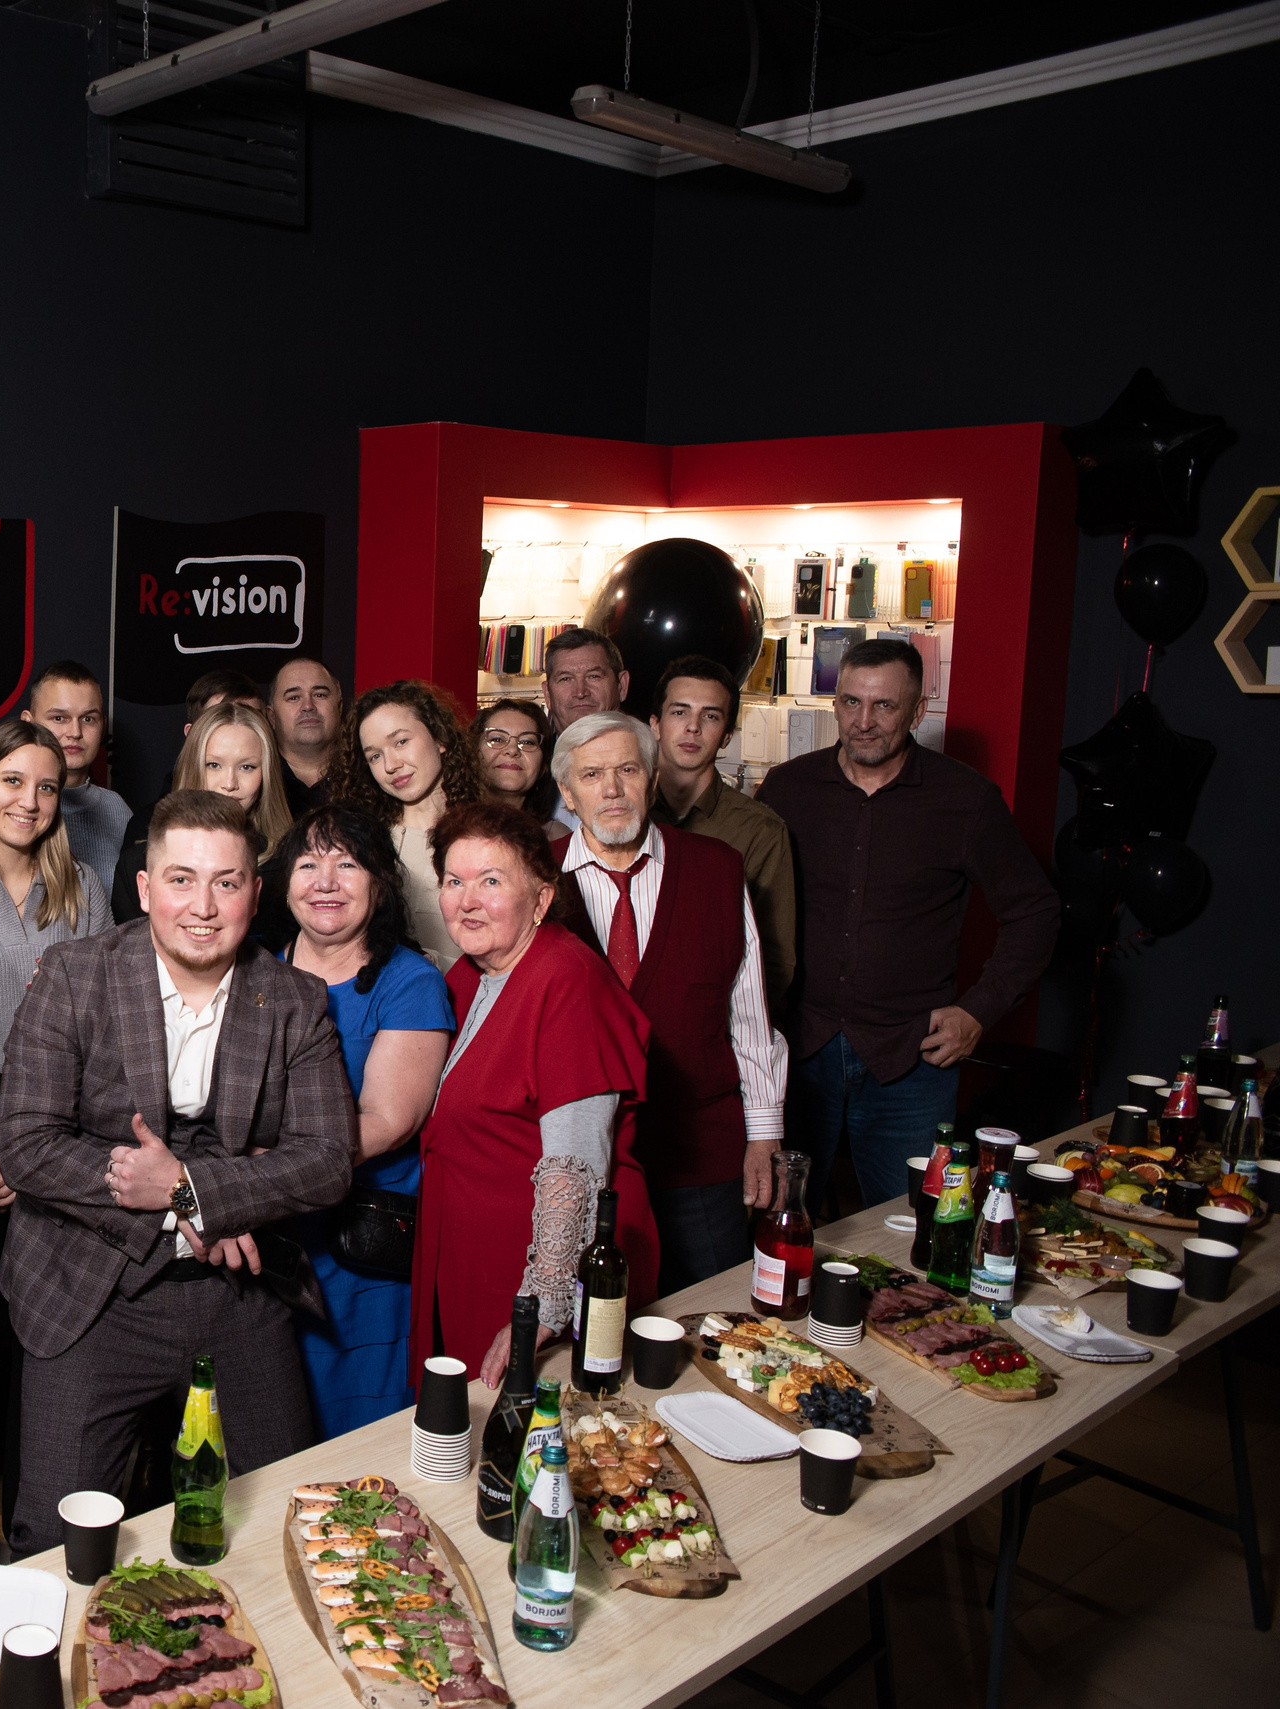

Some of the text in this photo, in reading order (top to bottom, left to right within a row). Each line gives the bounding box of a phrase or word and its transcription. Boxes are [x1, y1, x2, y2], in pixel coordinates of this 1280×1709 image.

[138, 574, 287, 617] Re:vision
[989, 1193, 1001, 1221] BORJOMI
[971, 1280, 999, 1294] BORJOMI
[551, 1475, 561, 1516] BORJOMI
[525, 1603, 567, 1617] BORJOMI
